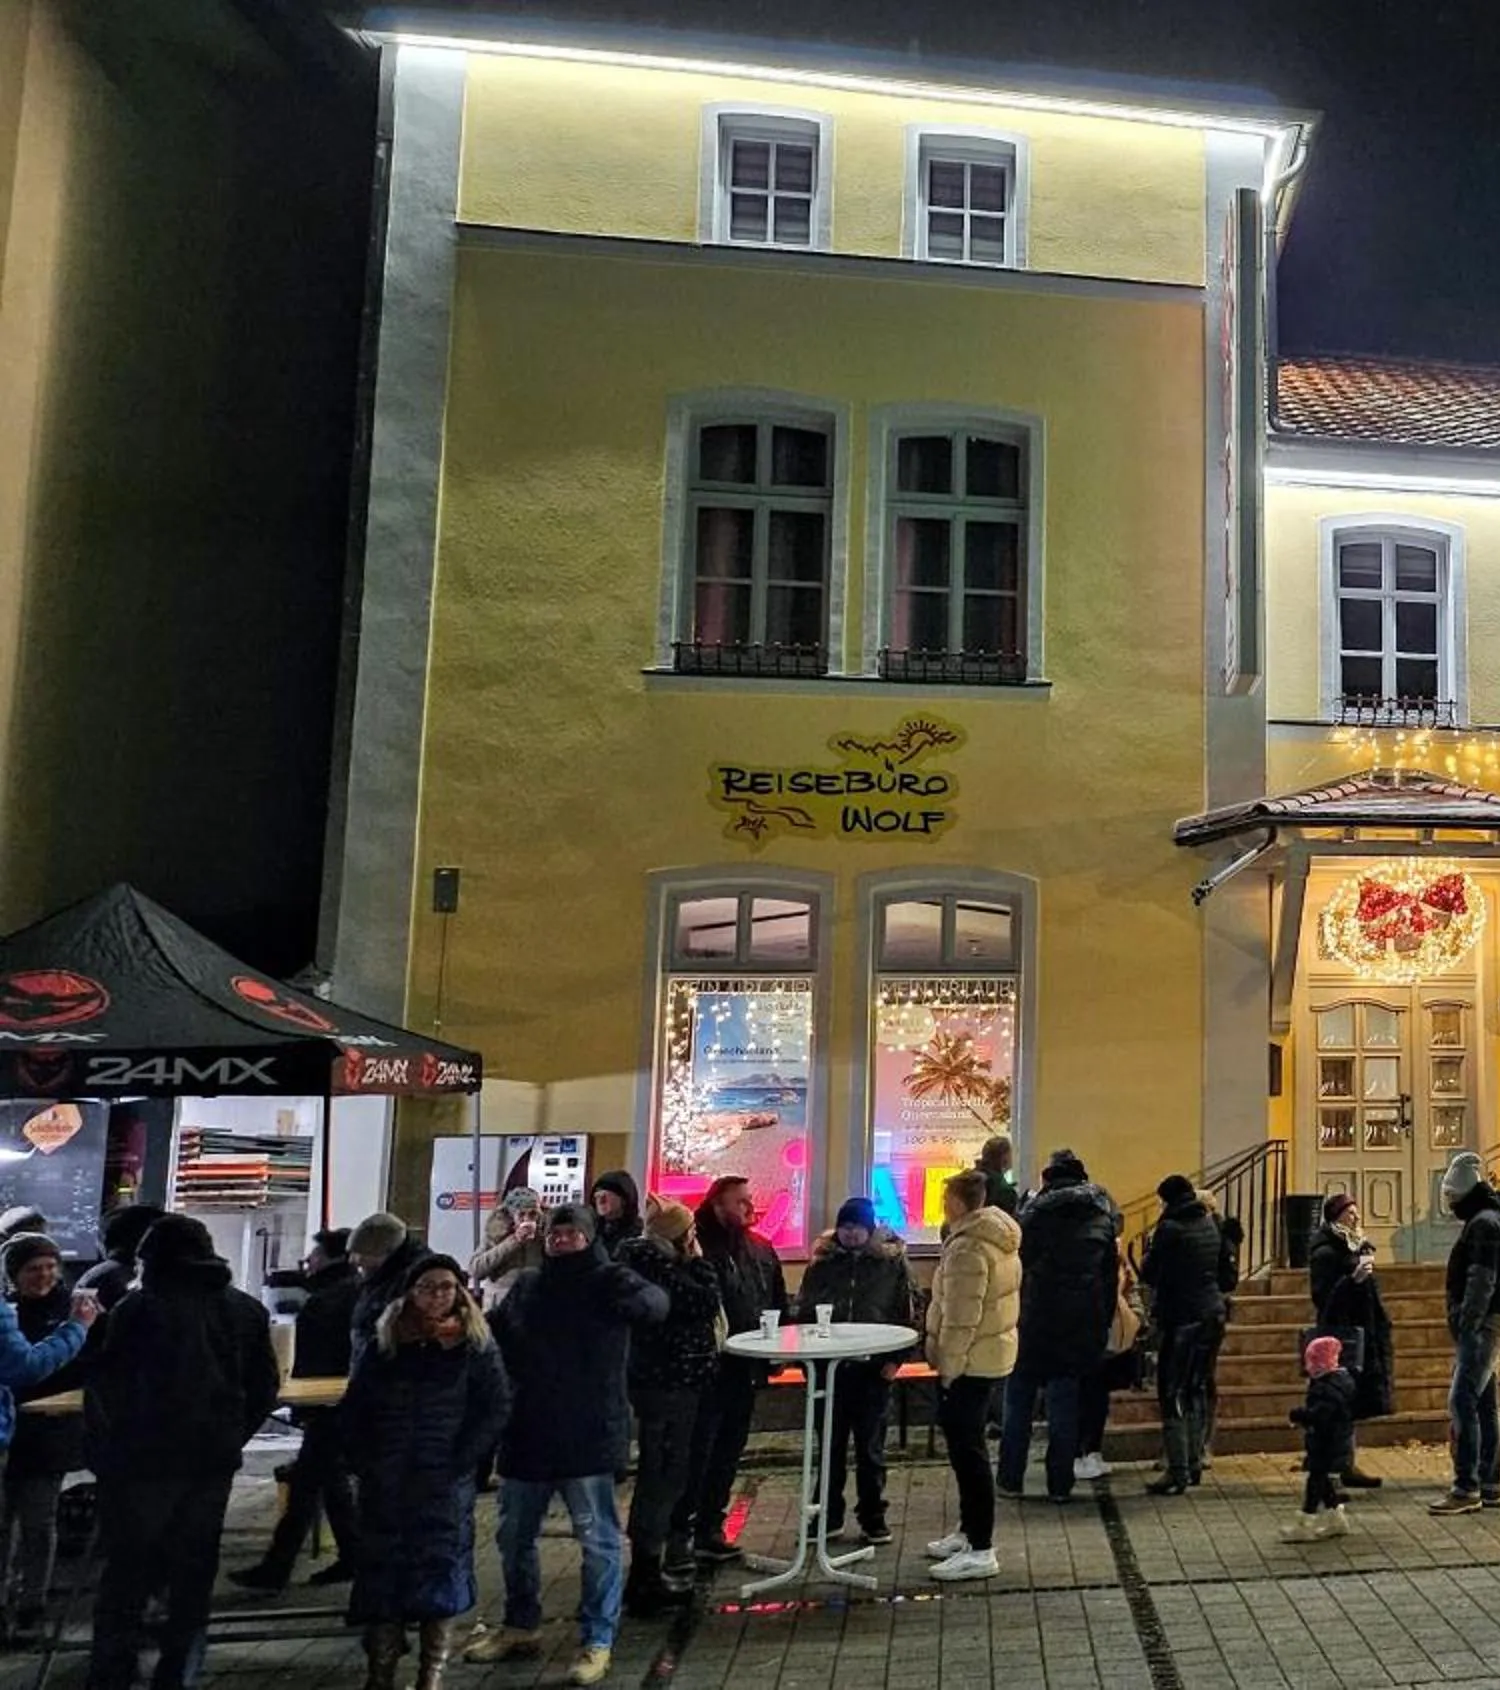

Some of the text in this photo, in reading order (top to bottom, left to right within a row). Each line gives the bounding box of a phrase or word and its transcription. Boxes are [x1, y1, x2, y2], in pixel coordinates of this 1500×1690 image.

[718, 757, 949, 796] REISEBÜRO
[841, 805, 945, 834] WOLF
[85, 1057, 279, 1085] 24MX
[361, 1058, 409, 1085] 24MX
